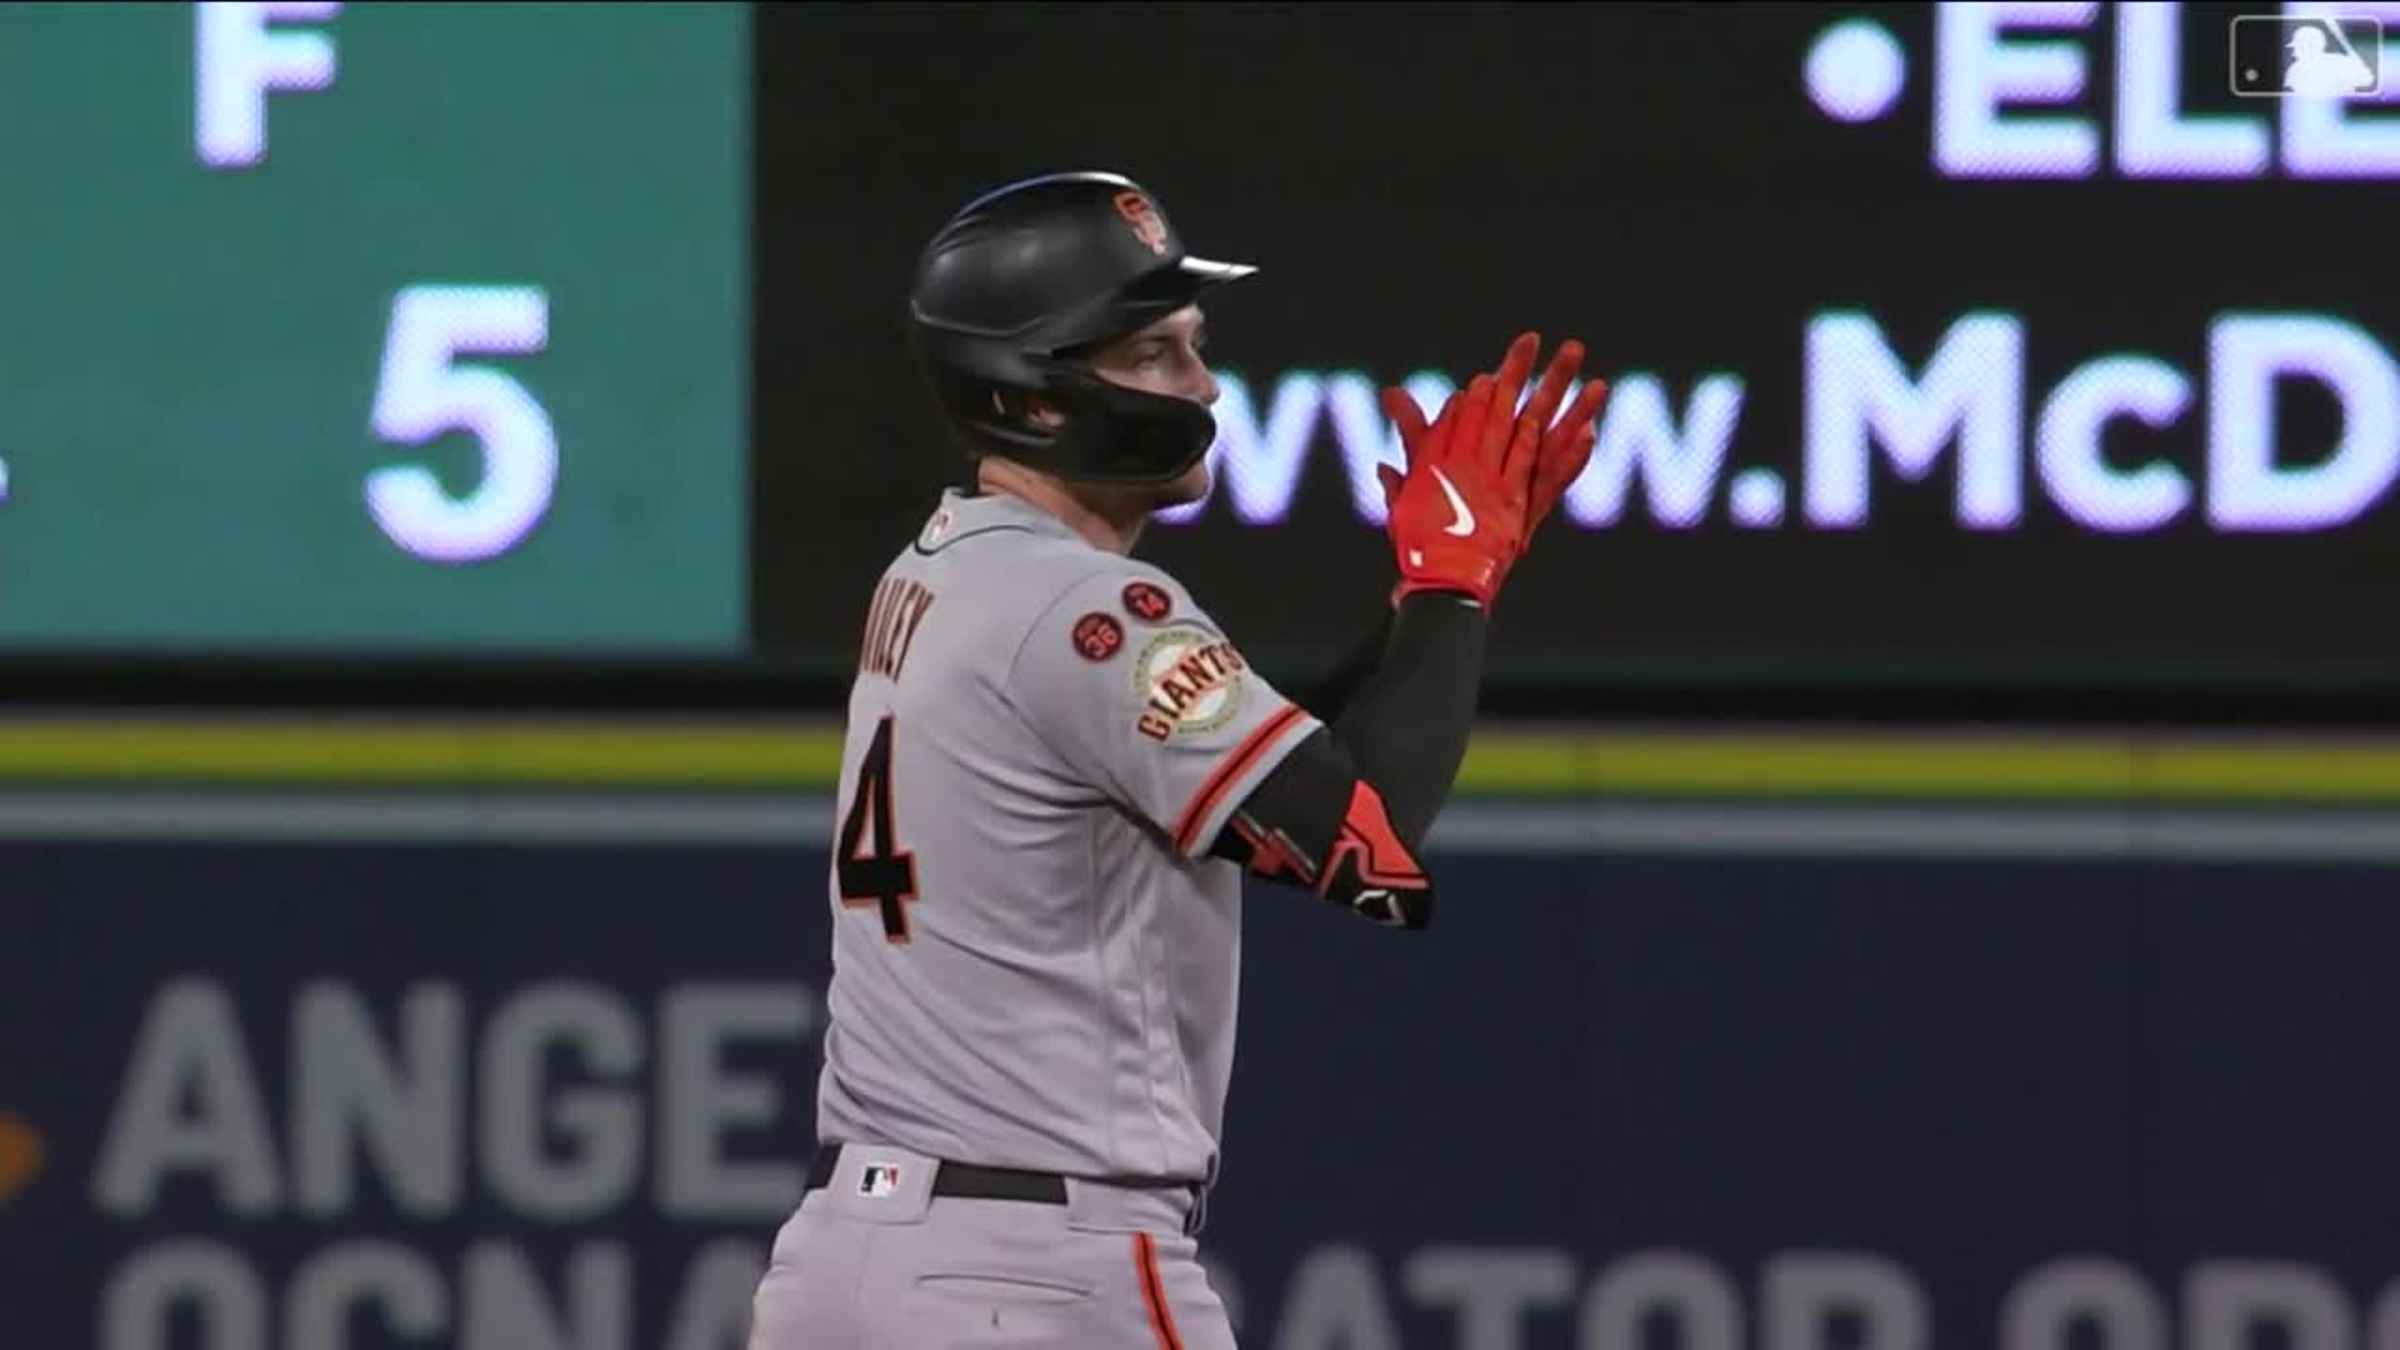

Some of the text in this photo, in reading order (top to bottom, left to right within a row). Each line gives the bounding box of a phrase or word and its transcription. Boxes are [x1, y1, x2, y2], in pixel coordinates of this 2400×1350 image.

[364, 283, 560, 564] 5
[837, 714, 919, 945] 4
[92, 976, 816, 1220] ANGE
